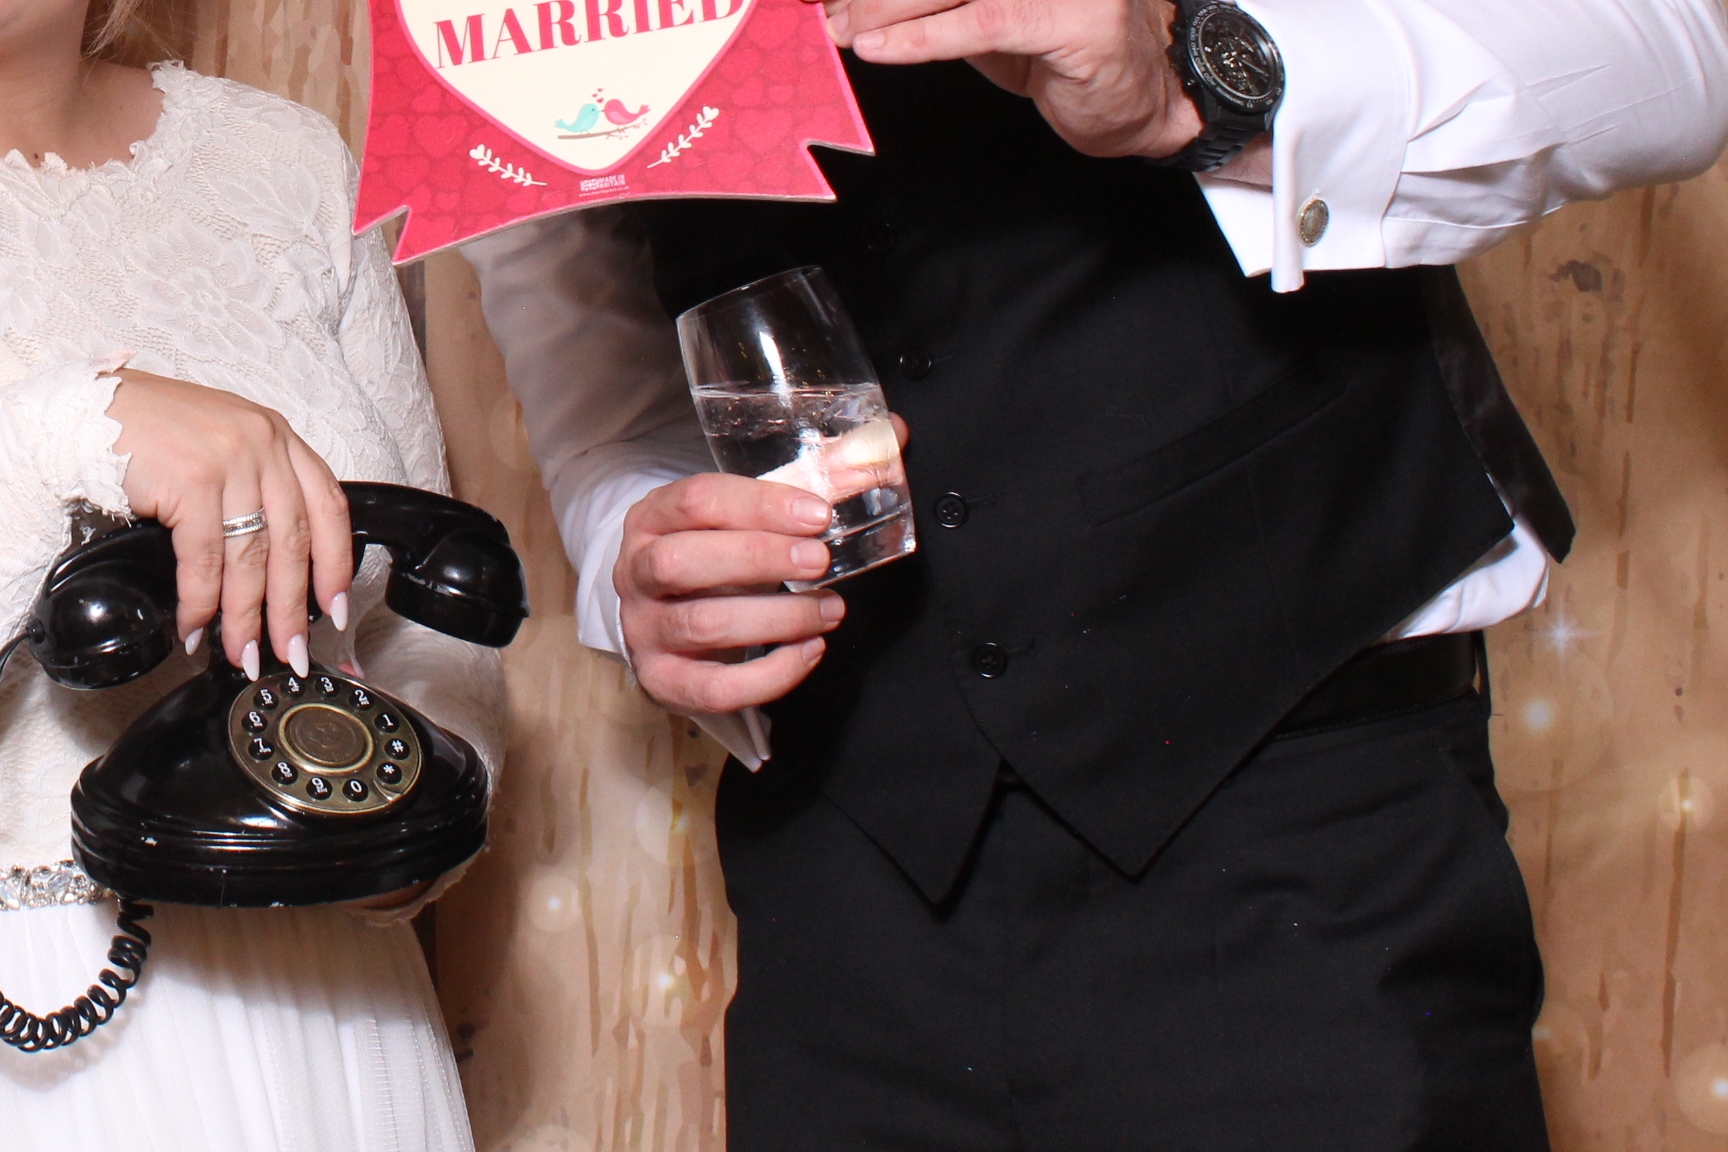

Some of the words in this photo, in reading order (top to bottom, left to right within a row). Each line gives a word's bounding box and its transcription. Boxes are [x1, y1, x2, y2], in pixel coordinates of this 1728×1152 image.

[598, 175, 617, 183] MADE
[288, 676, 299, 688] 4
[320, 676, 333, 688] 3
[260, 689, 272, 701] 5
[354, 689, 367, 701] 2
[248, 711, 261, 723] 6
[382, 713, 394, 727] 1
[253, 737, 265, 750] 7
[277, 761, 290, 775] 8
[311, 777, 324, 791] 9
[350, 780, 362, 793] 0
